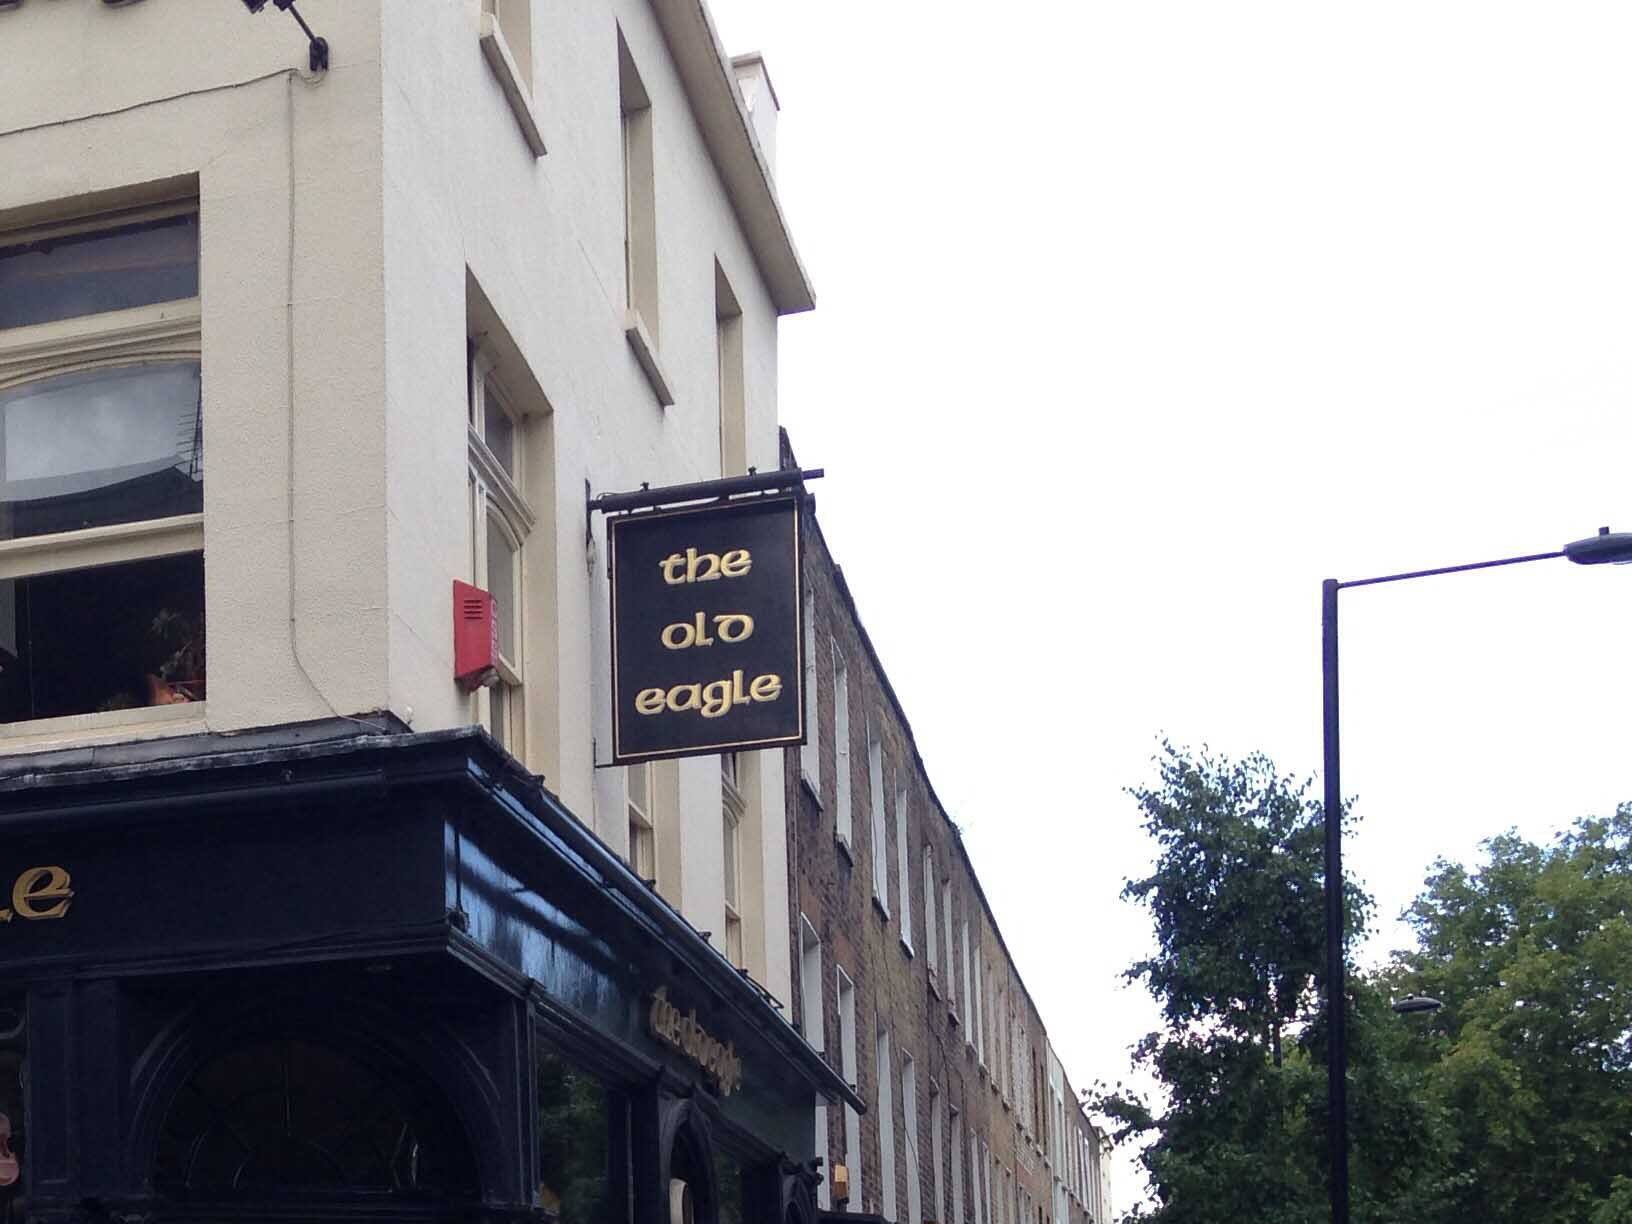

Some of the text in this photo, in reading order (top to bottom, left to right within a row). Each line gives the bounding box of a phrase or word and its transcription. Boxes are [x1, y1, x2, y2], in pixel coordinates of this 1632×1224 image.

[659, 547, 752, 584] the
[661, 611, 755, 650] old
[635, 669, 783, 718] eagle
